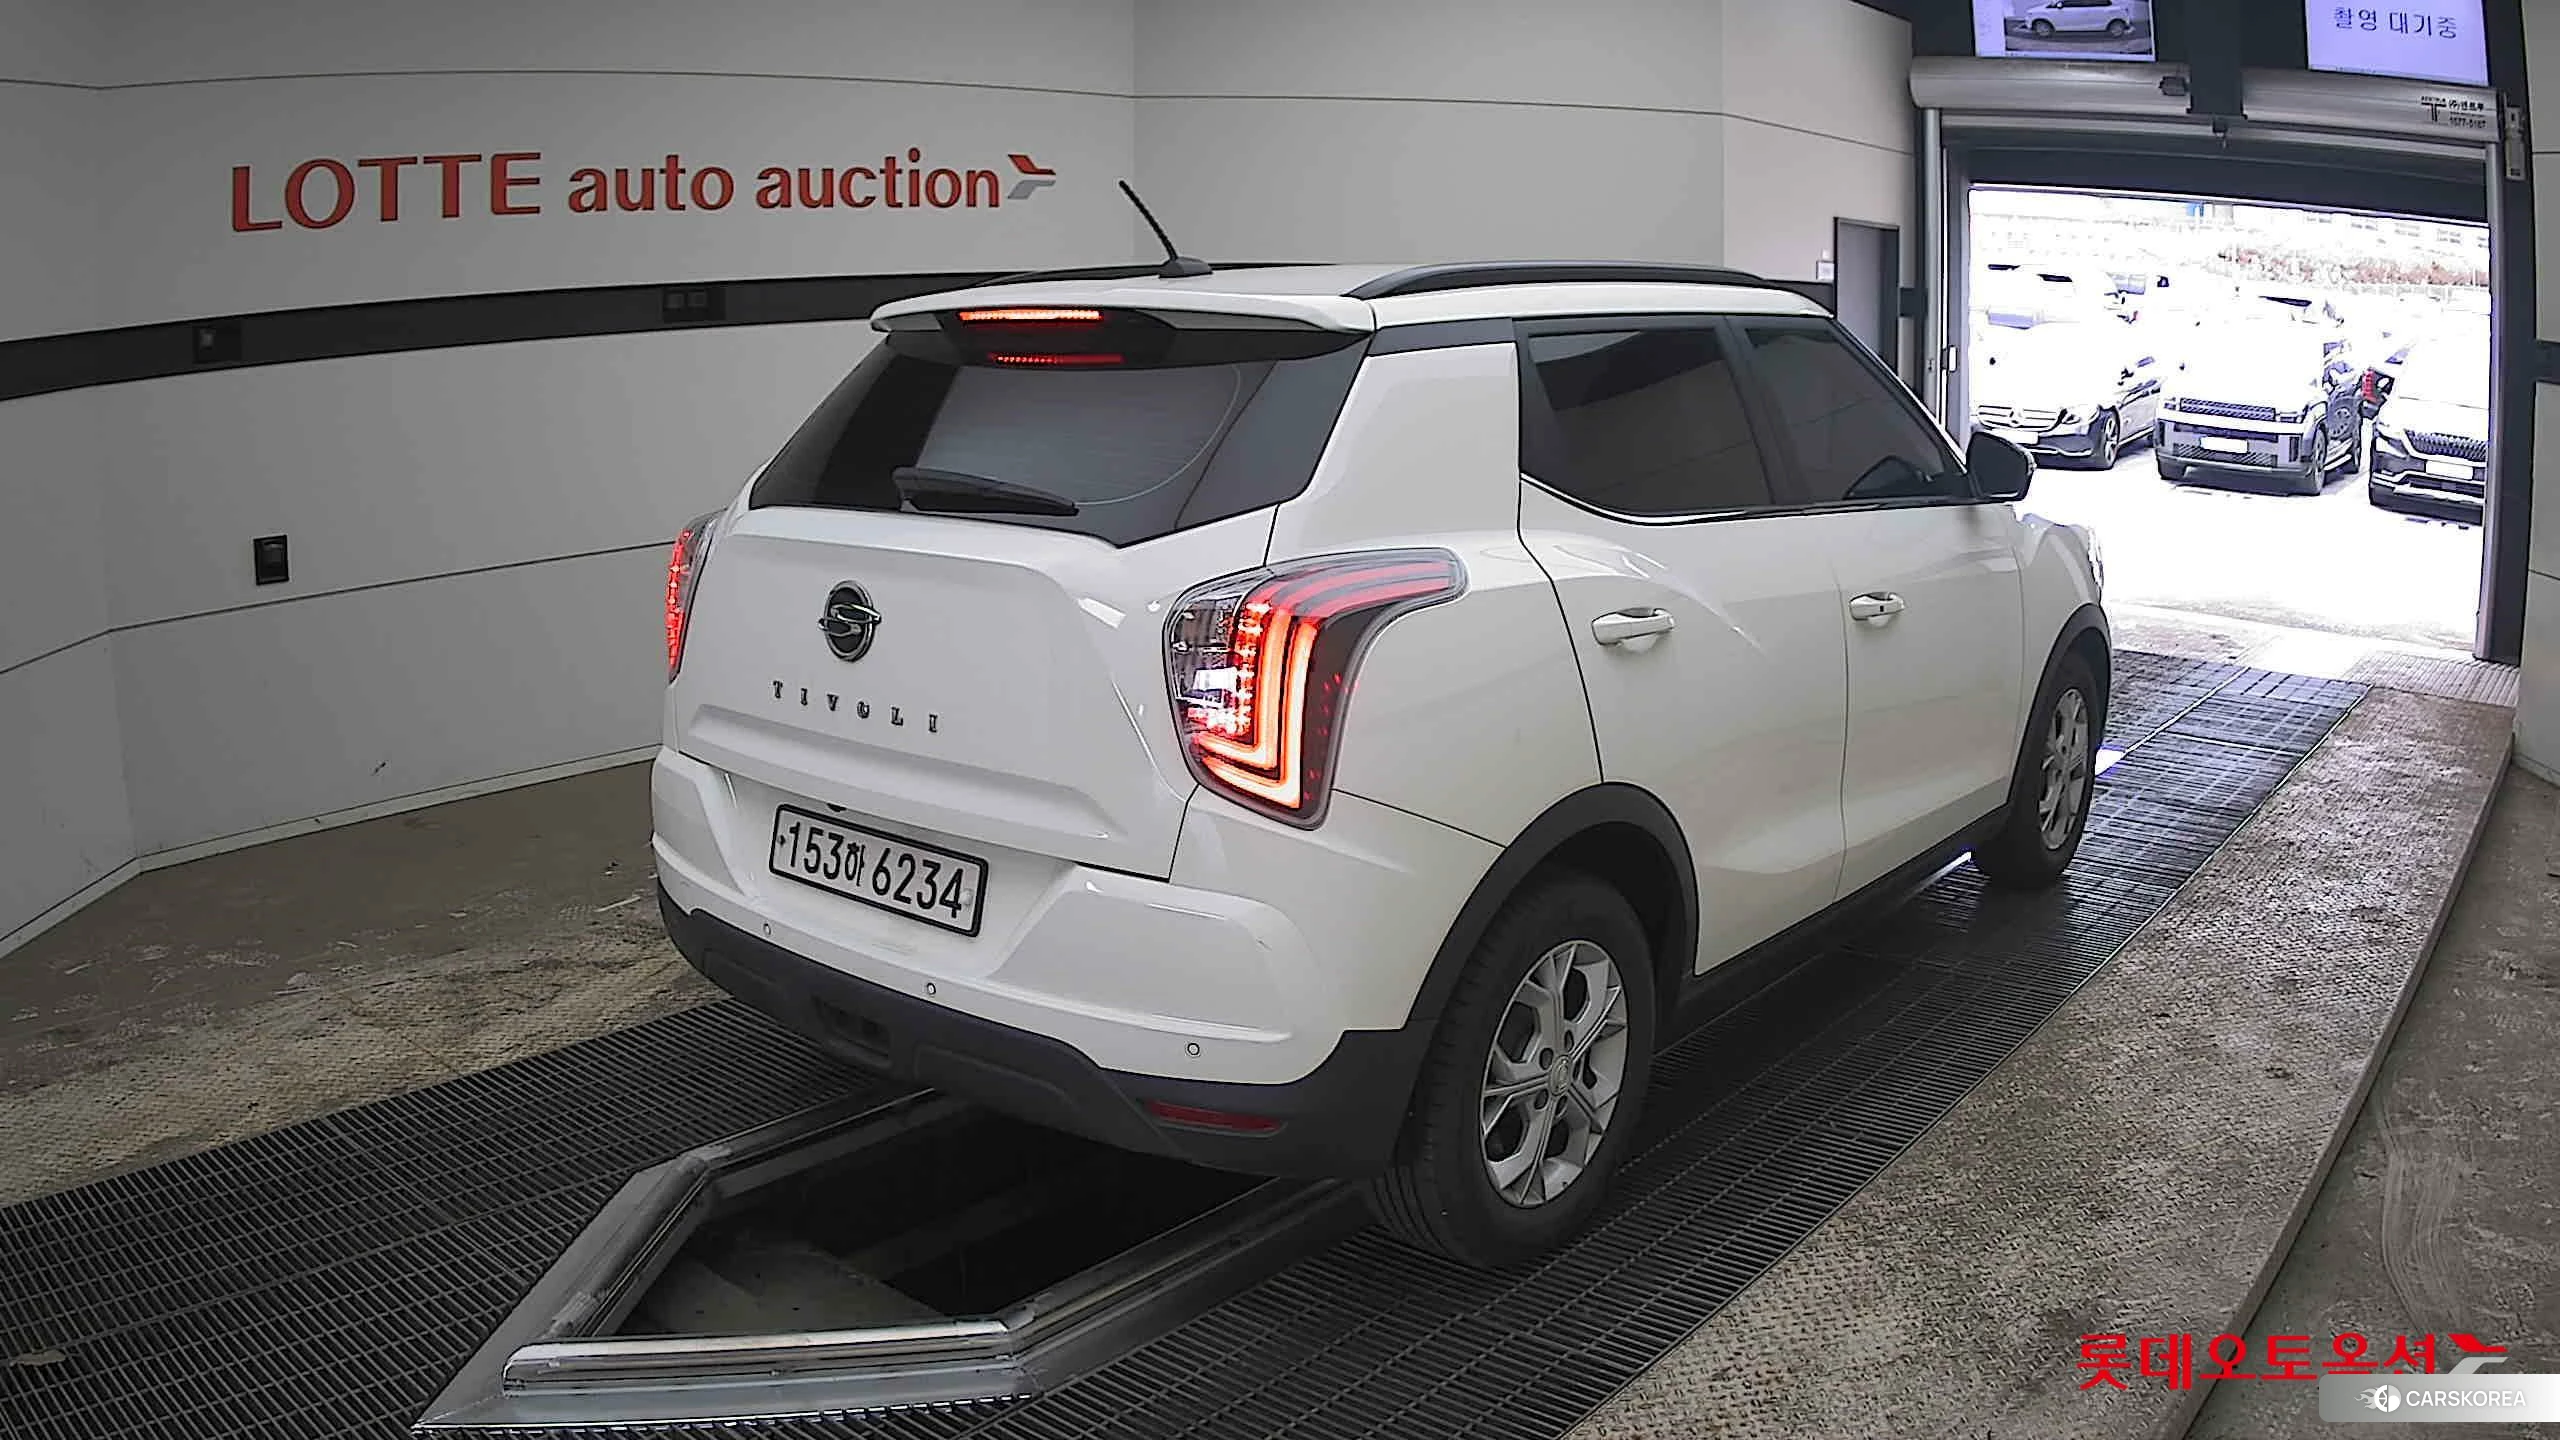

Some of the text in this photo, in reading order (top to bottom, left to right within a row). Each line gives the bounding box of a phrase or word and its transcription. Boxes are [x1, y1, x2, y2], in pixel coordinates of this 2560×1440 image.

[2334, 7, 2457, 39] 촬영 대기중
[233, 148, 1002, 232] LOTTE auto auction
[772, 680, 939, 733] TIVOLI
[789, 821, 964, 918] 153하 6234
